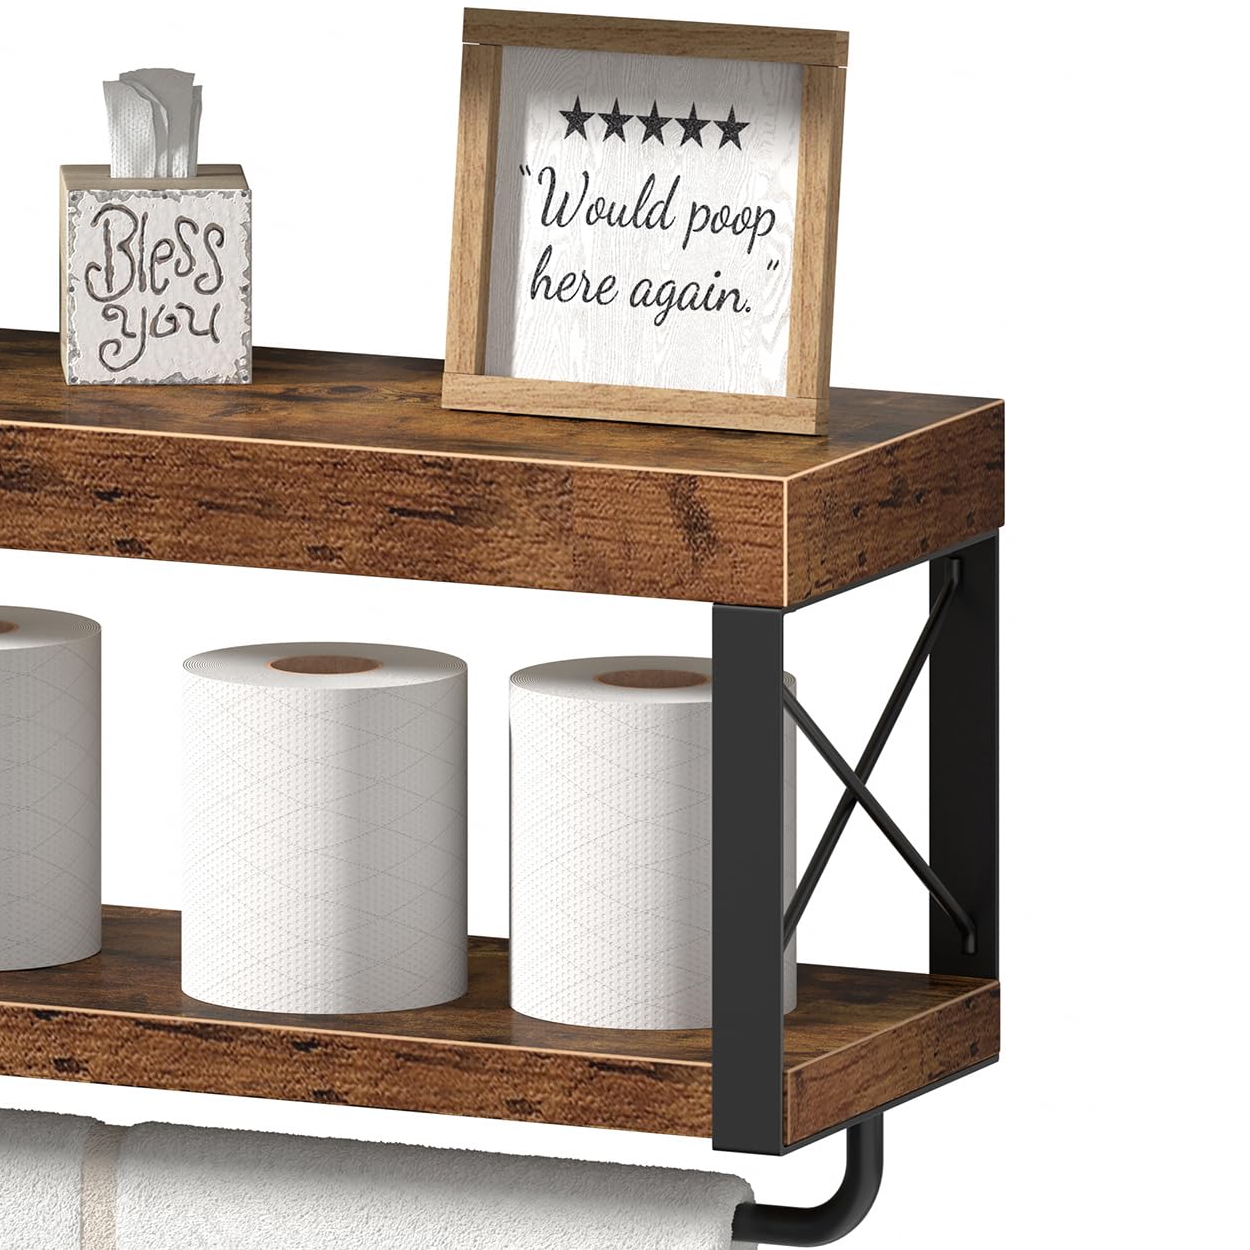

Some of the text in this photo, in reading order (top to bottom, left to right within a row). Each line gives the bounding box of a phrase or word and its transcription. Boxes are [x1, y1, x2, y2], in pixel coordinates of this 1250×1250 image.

[86, 203, 226, 302] Bless
[681, 200, 778, 256] poop
[532, 244, 617, 306] here
